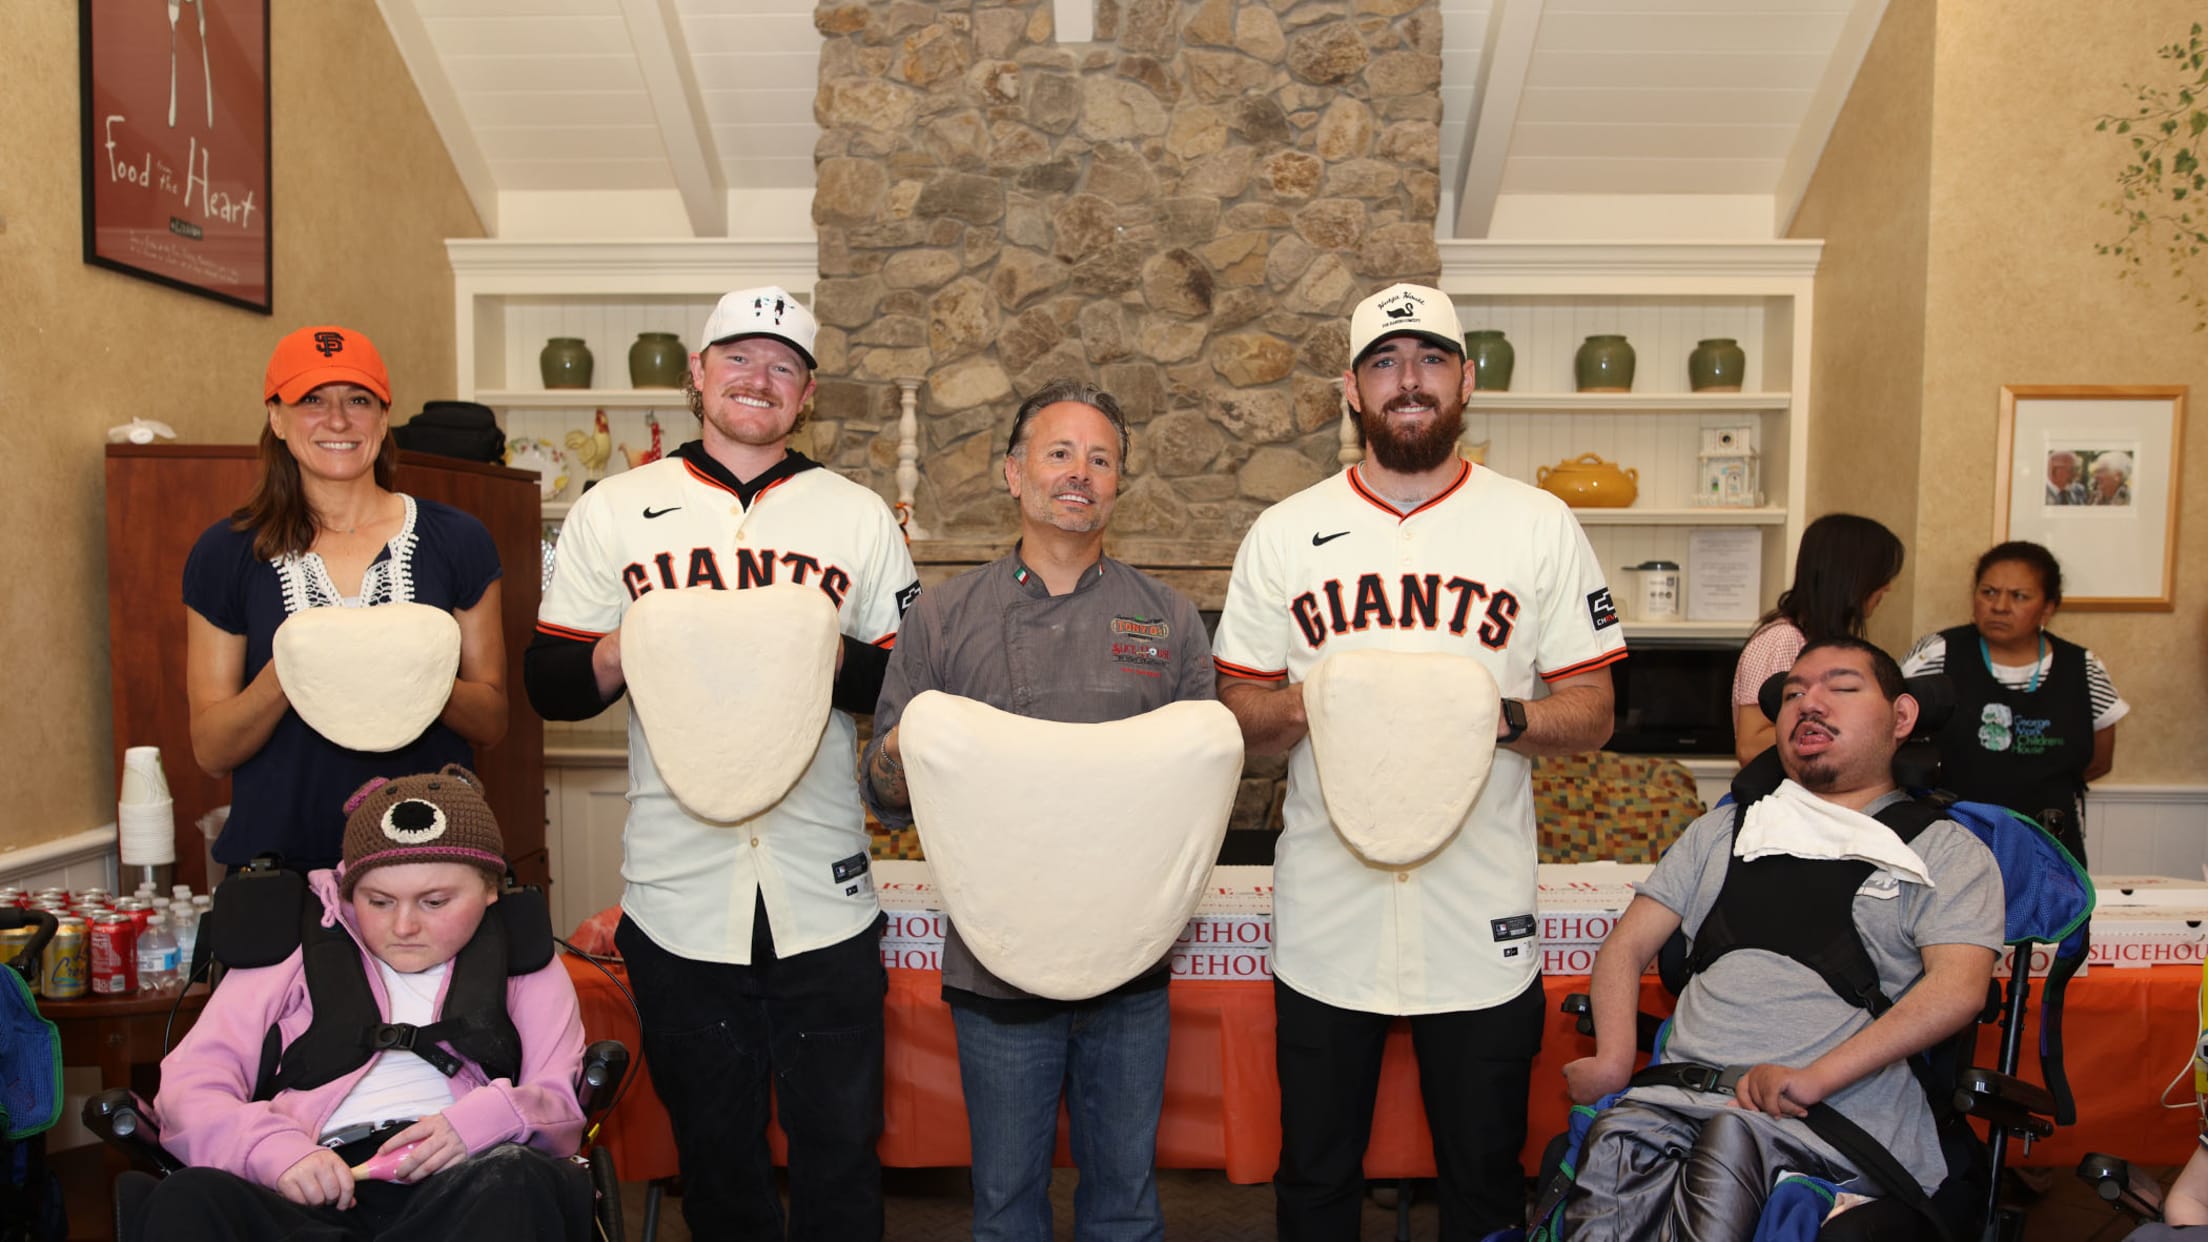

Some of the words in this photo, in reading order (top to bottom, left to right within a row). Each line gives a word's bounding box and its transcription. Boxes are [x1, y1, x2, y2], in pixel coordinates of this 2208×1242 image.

[105, 115, 151, 188] Food
[159, 174, 178, 194] the
[184, 136, 256, 229] Heart
[314, 331, 345, 357] SF
[622, 547, 852, 610] GIANTS
[1290, 573, 1521, 652] GIANTS
[1543, 917, 1618, 939] EHO
[1543, 949, 1599, 971] HO
